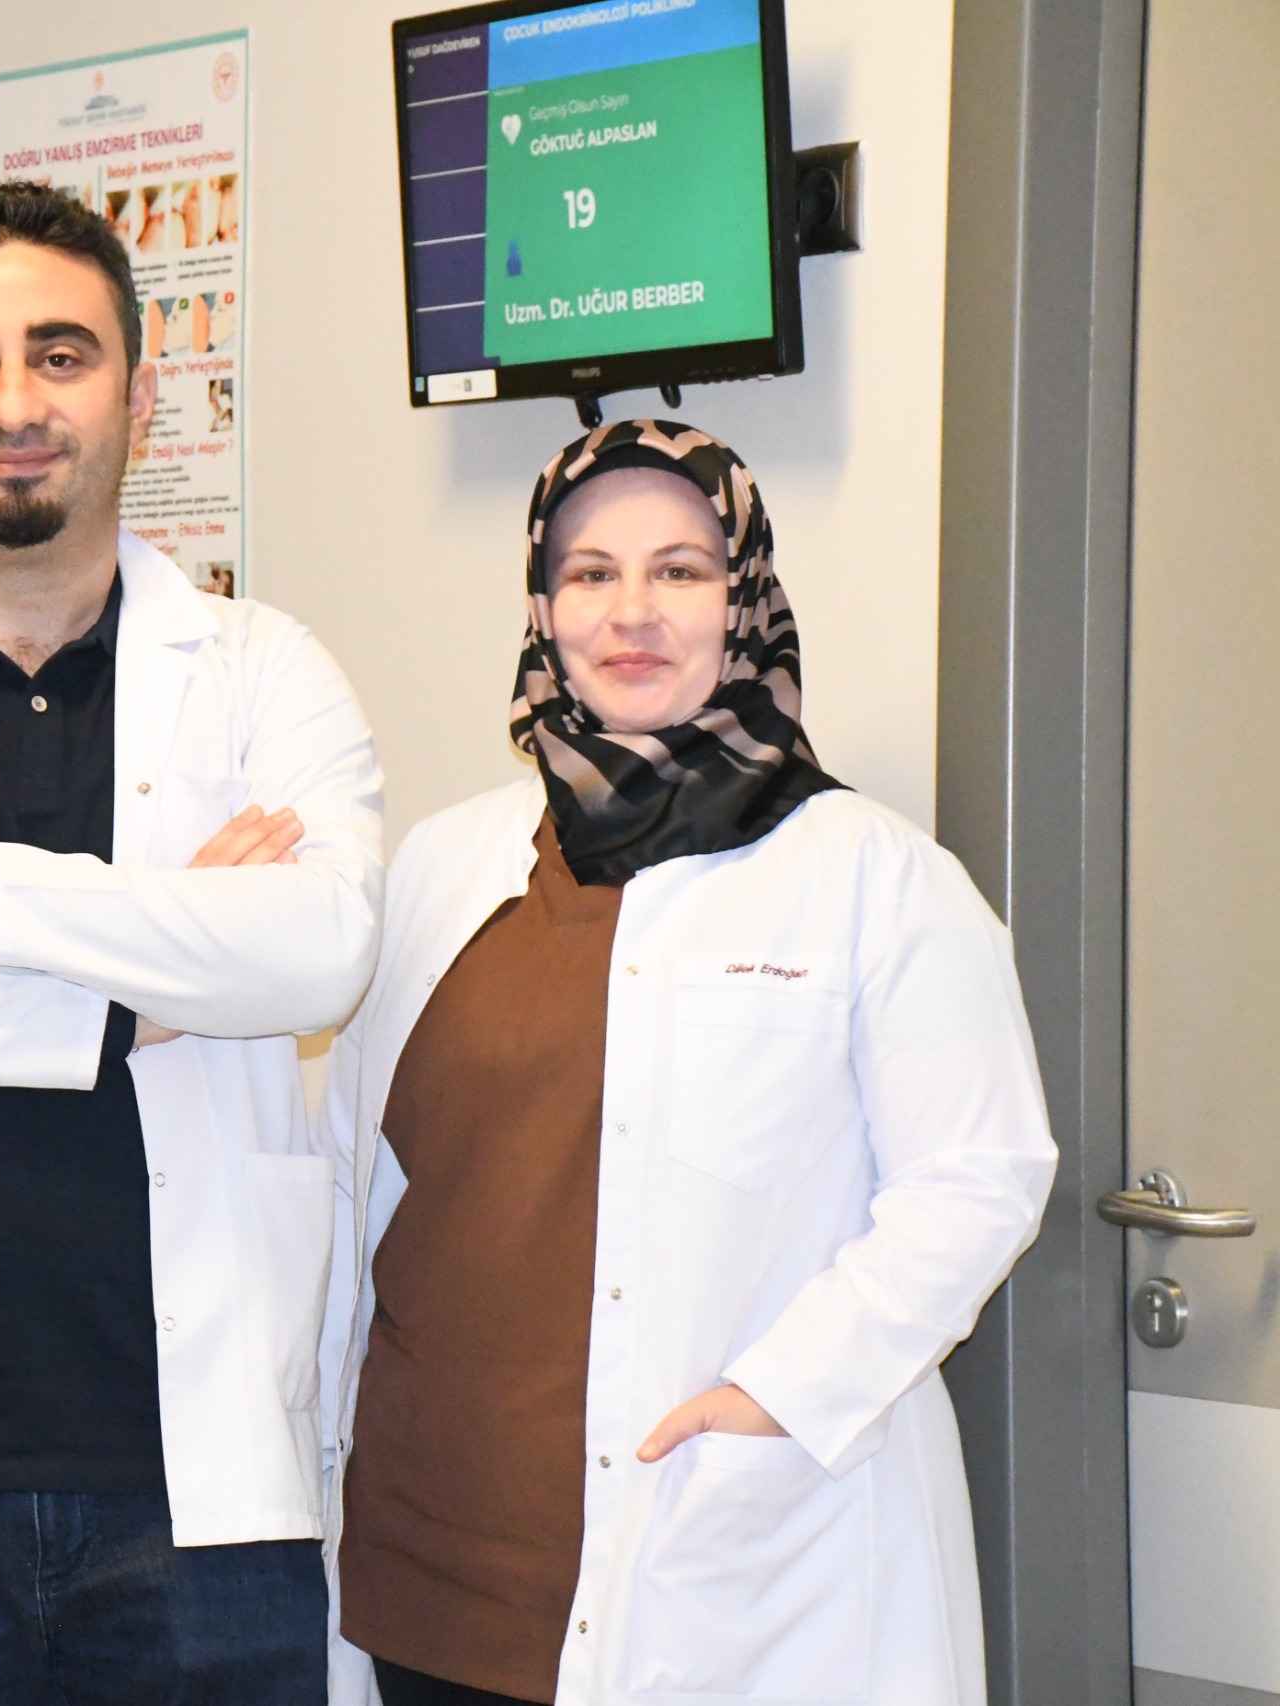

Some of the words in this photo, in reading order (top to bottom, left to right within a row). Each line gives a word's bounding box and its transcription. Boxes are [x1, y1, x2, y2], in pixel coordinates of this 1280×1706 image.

[504, 22, 540, 44] ÇOCUK
[529, 104, 568, 121] Geçmiş
[570, 98, 600, 115] Olsun
[600, 93, 630, 110] Sayın
[4, 148, 41, 170] DOĞRU
[45, 144, 83, 164] YANLIŞ
[86, 132, 137, 157] EMZİRME
[140, 119, 203, 148] TEKNİKLERİ
[530, 129, 585, 156] GÖKTUĞ
[587, 121, 657, 147] ALPASLAN
[563, 187, 596, 229] 19
[505, 303, 546, 324] Uzm.
[550, 297, 575, 320] Dr.
[578, 287, 628, 316] UĞUR
[632, 280, 705, 310] BERBER
[760, 963, 808, 980] Erdoğan
